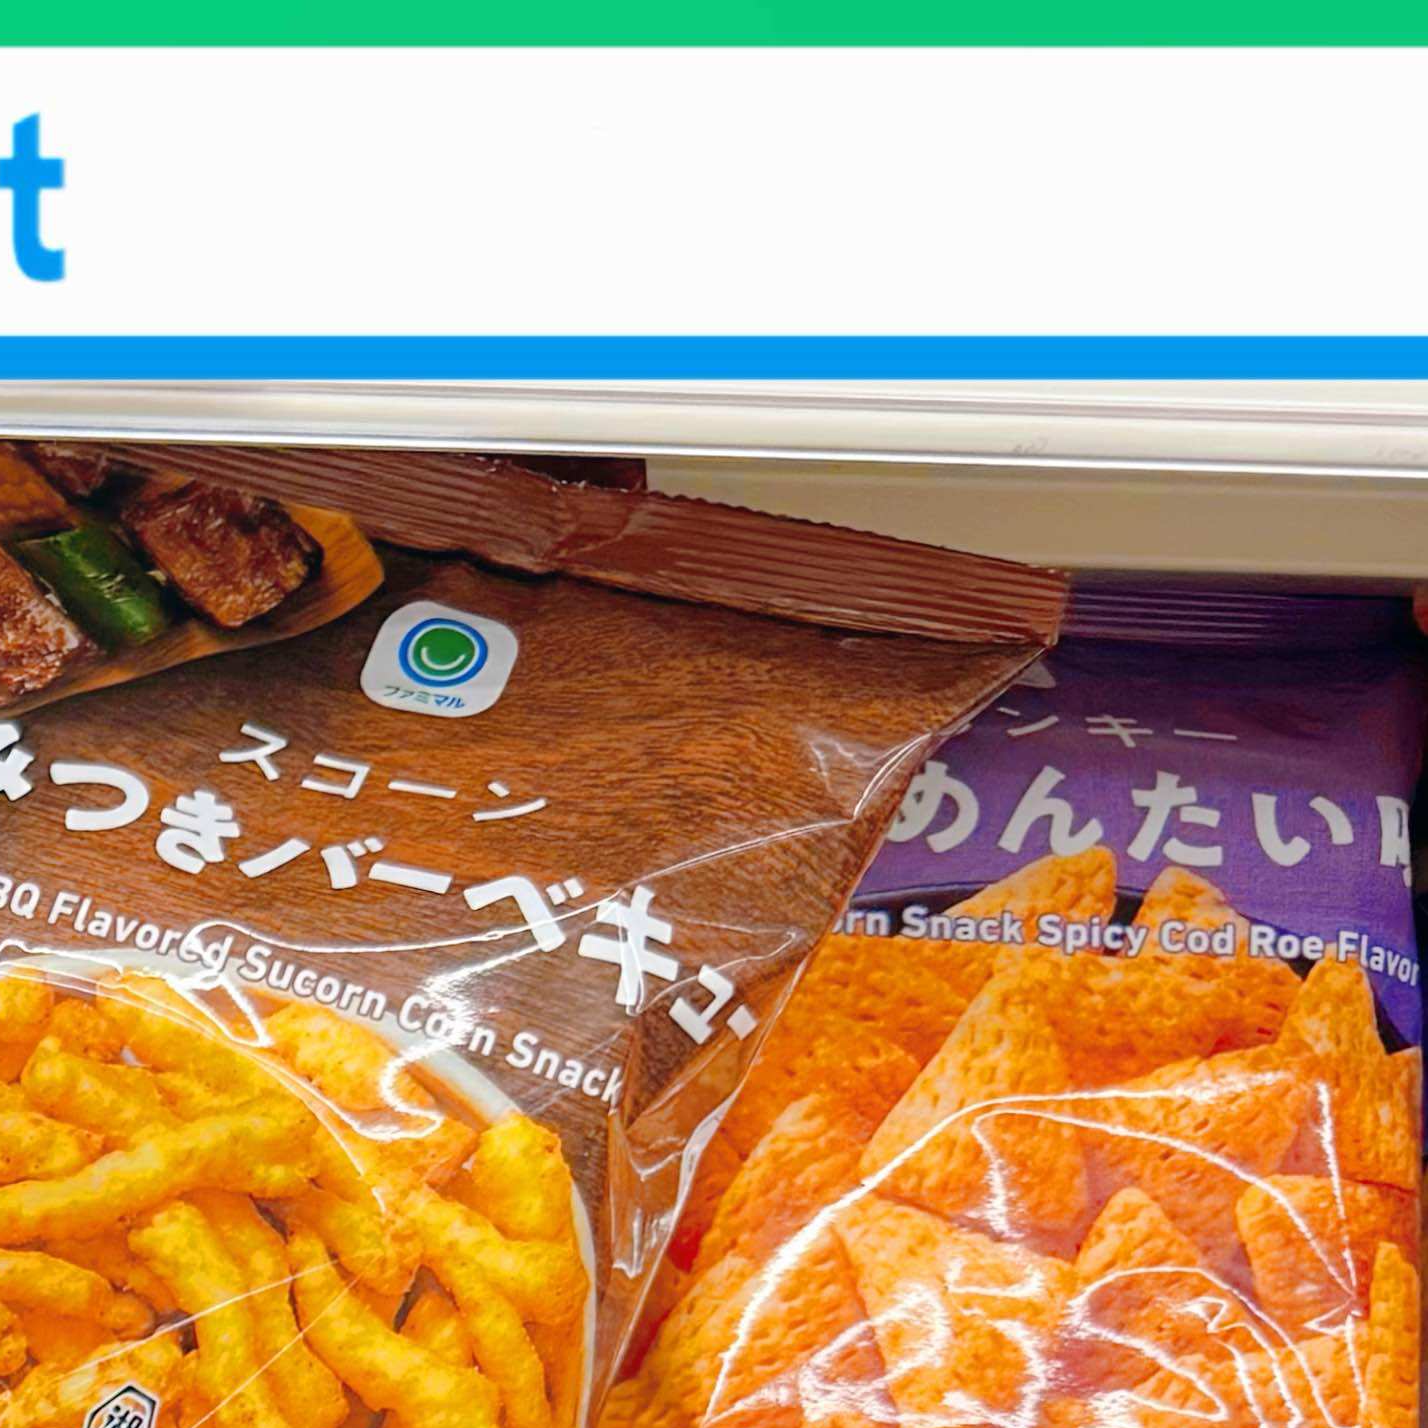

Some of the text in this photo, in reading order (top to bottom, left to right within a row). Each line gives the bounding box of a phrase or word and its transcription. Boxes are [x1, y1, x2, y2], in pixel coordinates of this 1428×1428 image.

[218, 722, 546, 822] スコーン
[902, 904, 1024, 947] Snack
[1037, 913, 1147, 957] Spicy
[1159, 920, 1236, 958] Cod
[1249, 924, 1325, 961] Roe
[47, 893, 228, 972] Flavored
[240, 944, 392, 1023] Sucorn
[508, 1028, 623, 1105] Snack
